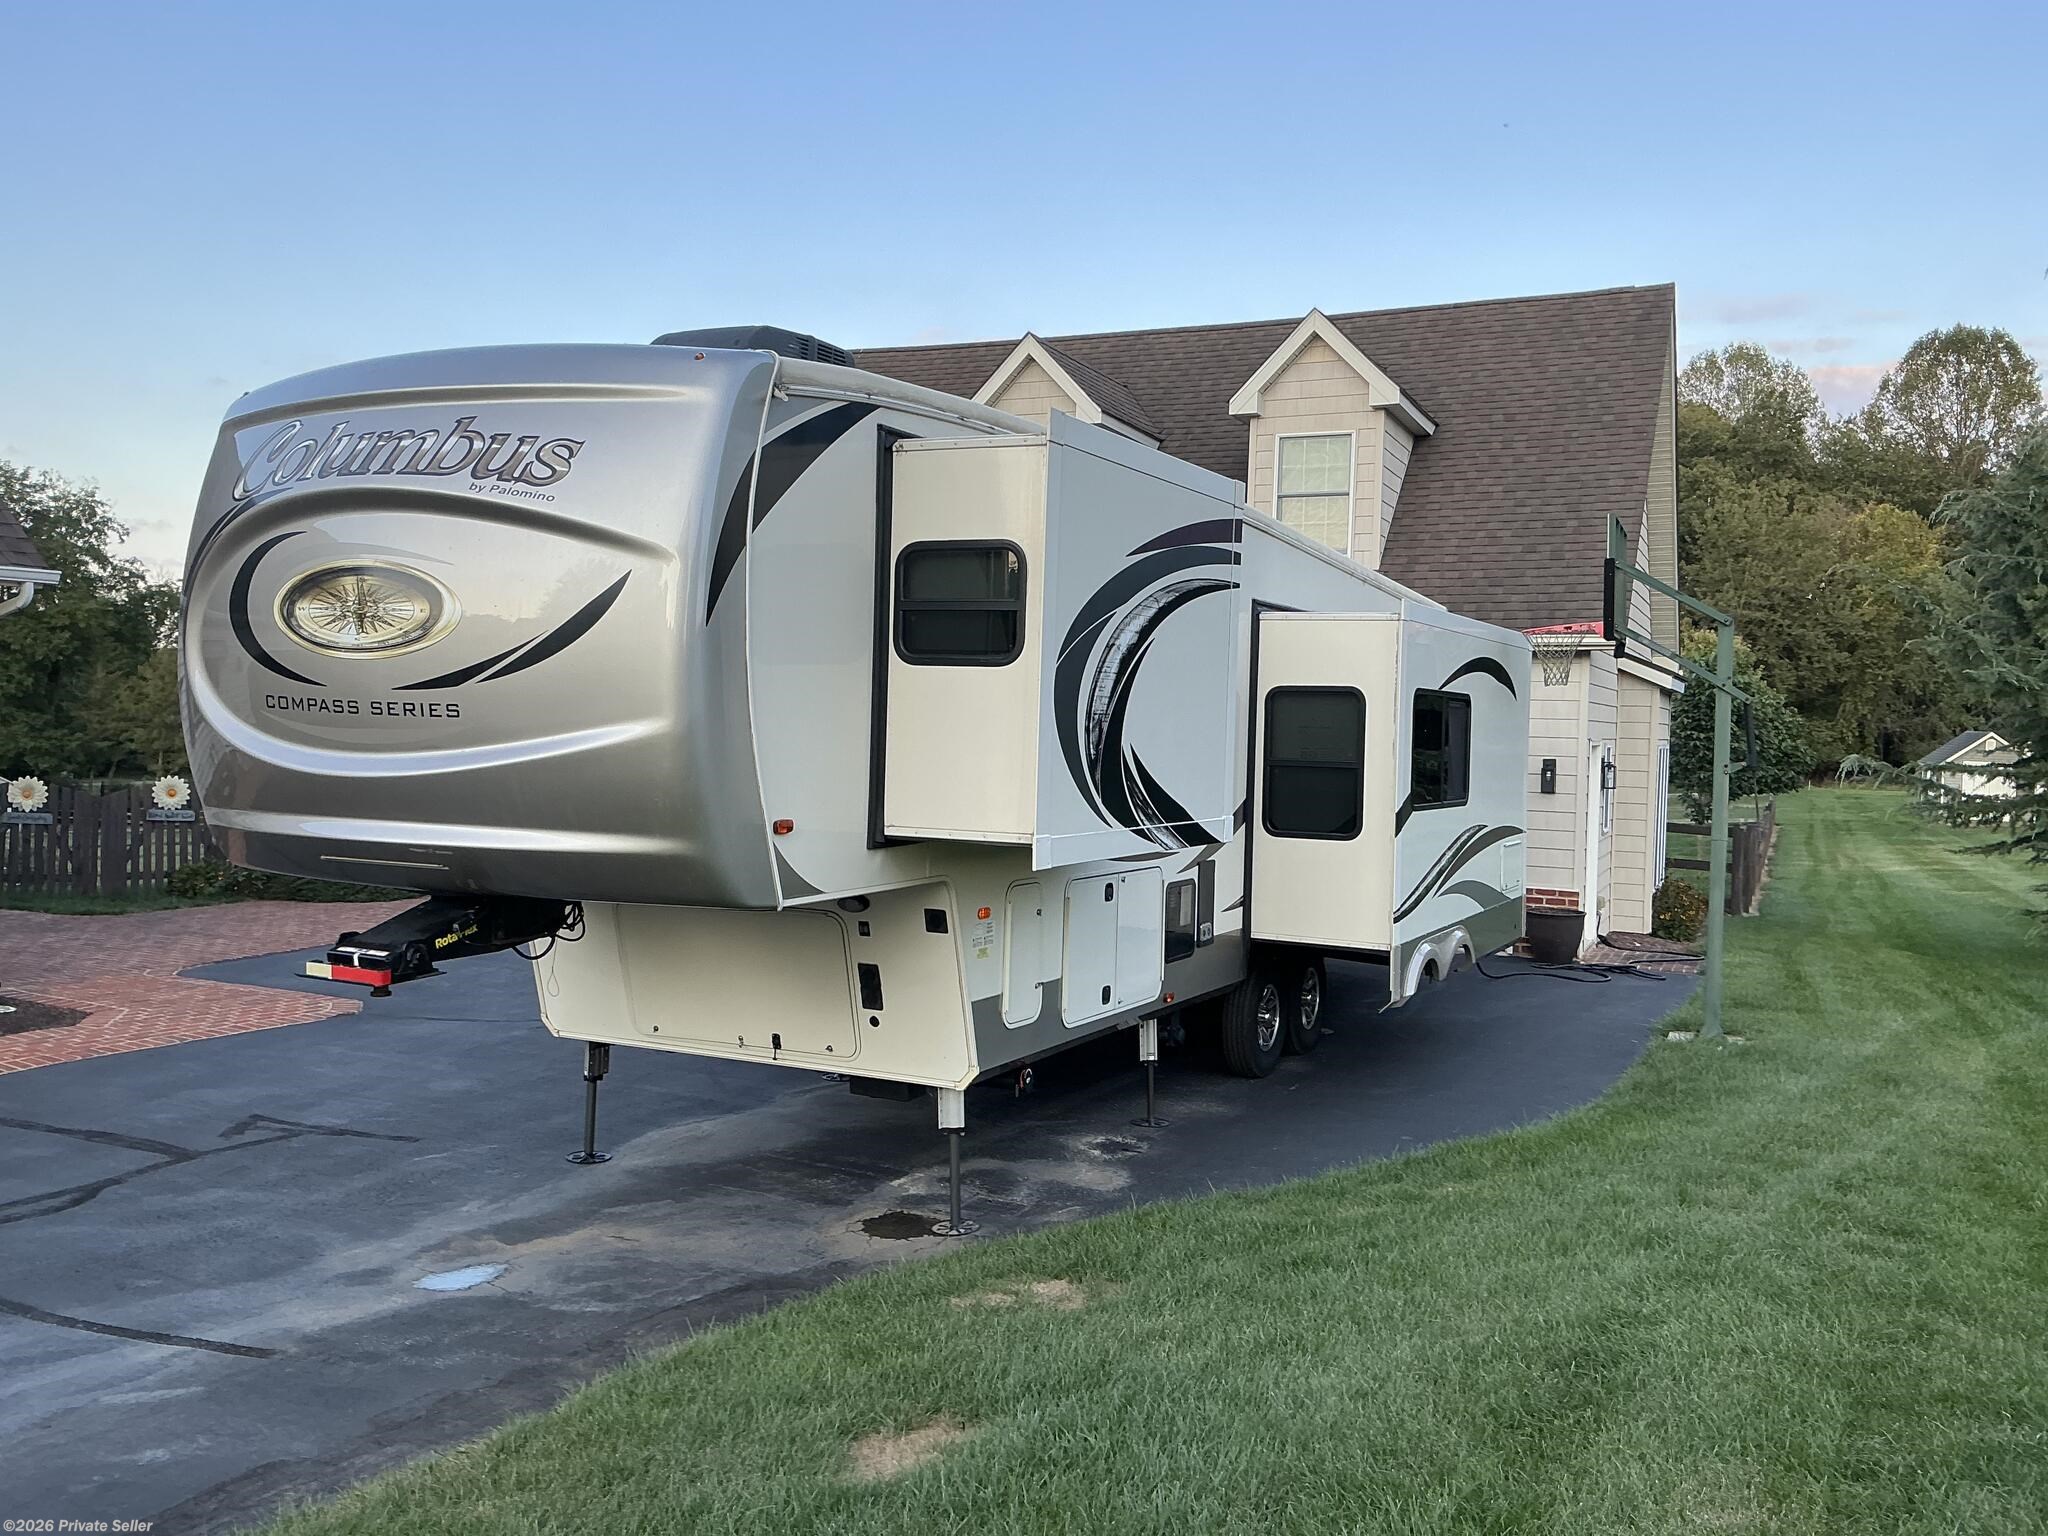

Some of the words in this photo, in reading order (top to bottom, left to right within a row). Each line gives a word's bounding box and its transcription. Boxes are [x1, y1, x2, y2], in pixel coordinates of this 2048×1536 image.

[232, 415, 586, 502] Columbus
[469, 482, 486, 494] by
[489, 484, 555, 502] Palomino
[265, 694, 360, 715] COMPASS
[370, 701, 460, 718] SERIES
